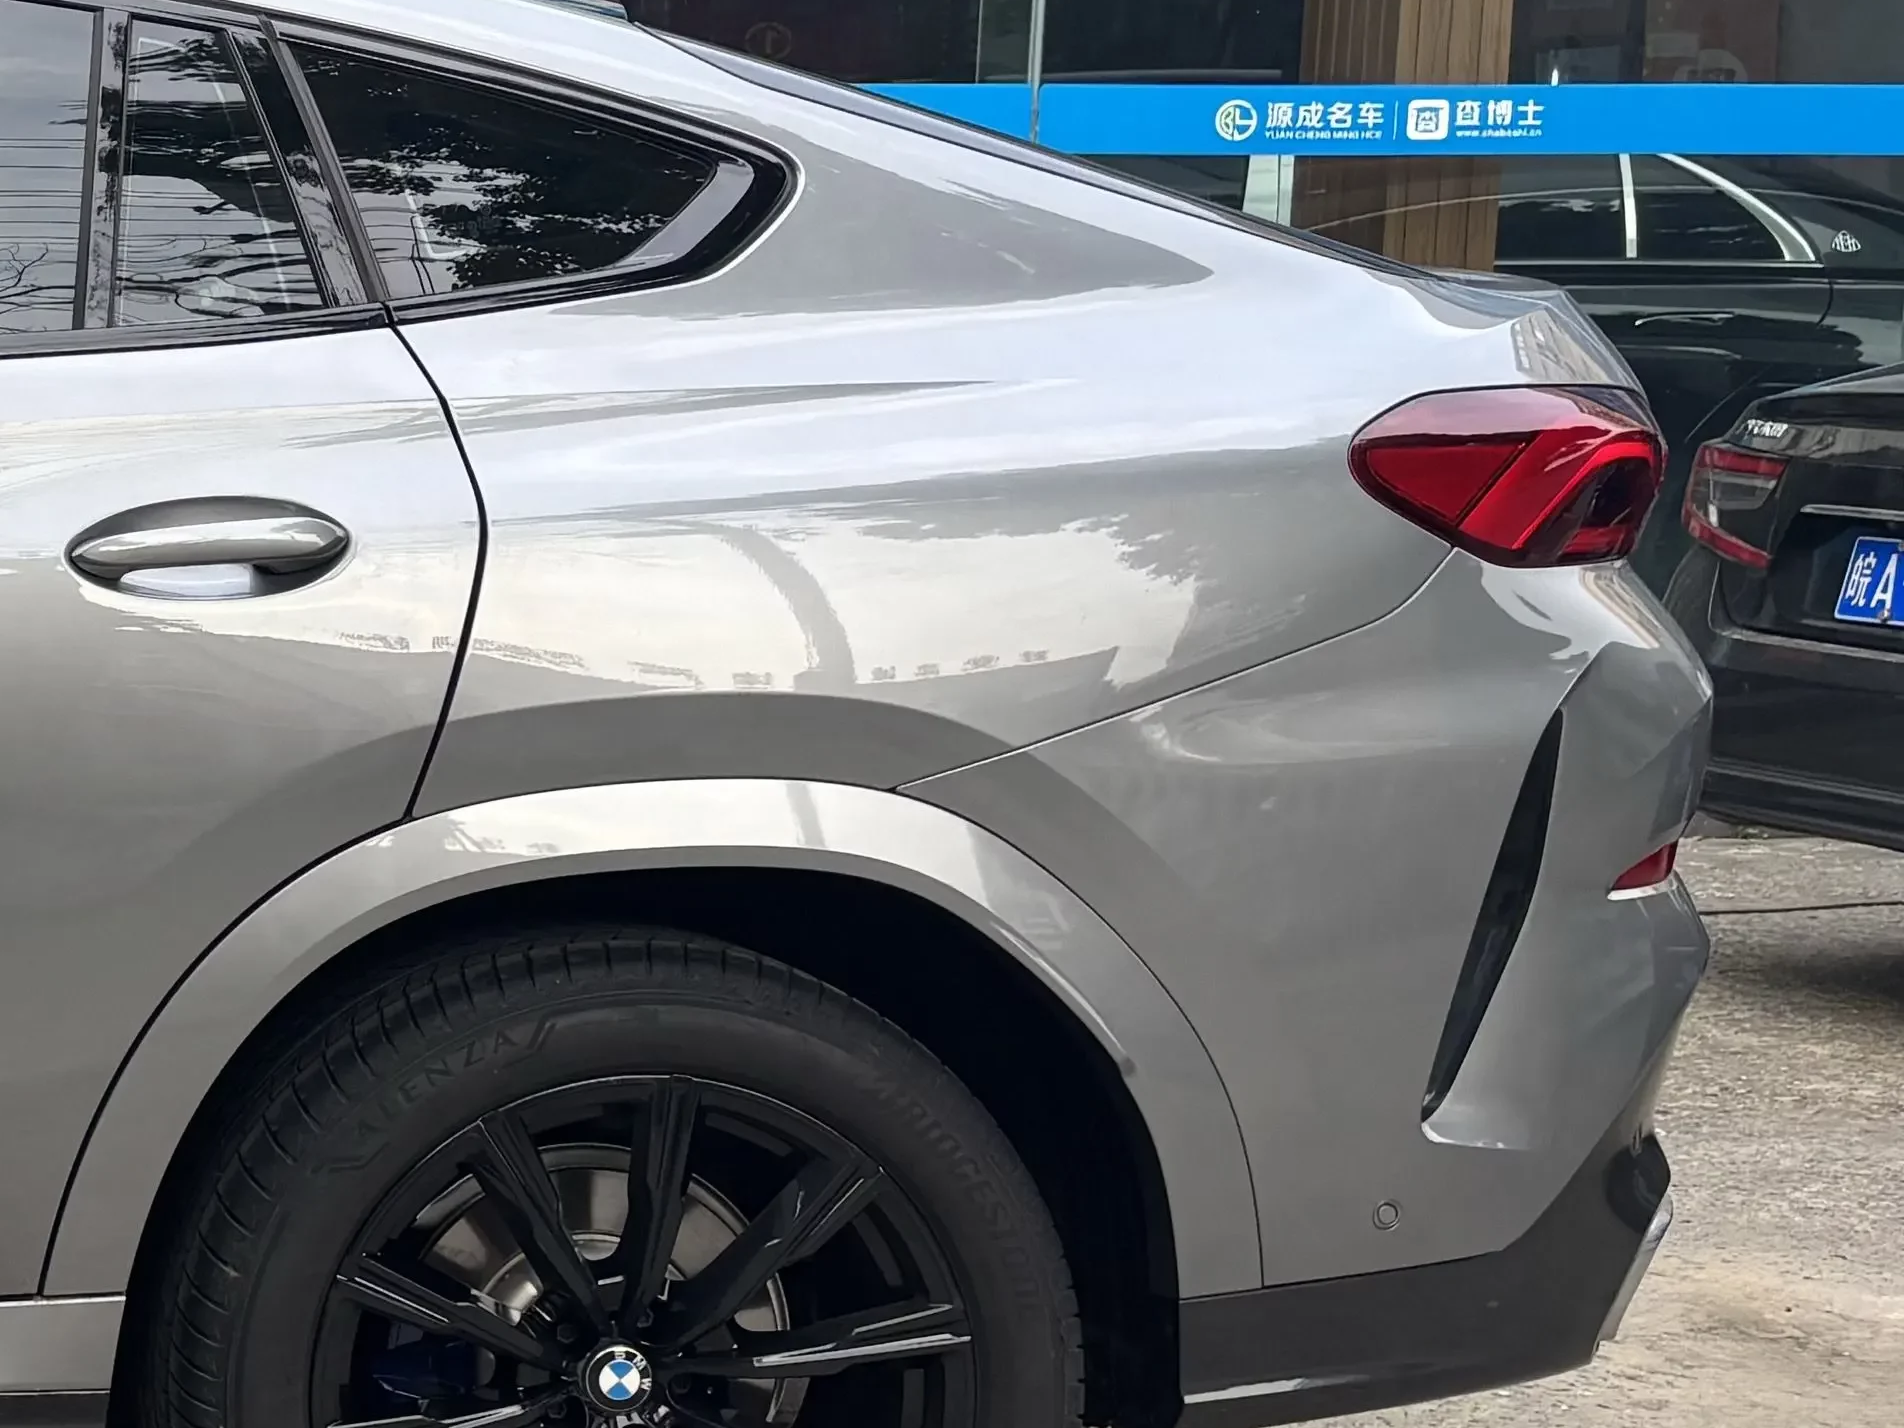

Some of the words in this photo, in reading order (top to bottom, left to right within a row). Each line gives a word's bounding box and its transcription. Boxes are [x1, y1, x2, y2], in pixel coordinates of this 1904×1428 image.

[1264, 100, 1385, 129] 源成名车
[1454, 99, 1547, 126] 查博士
